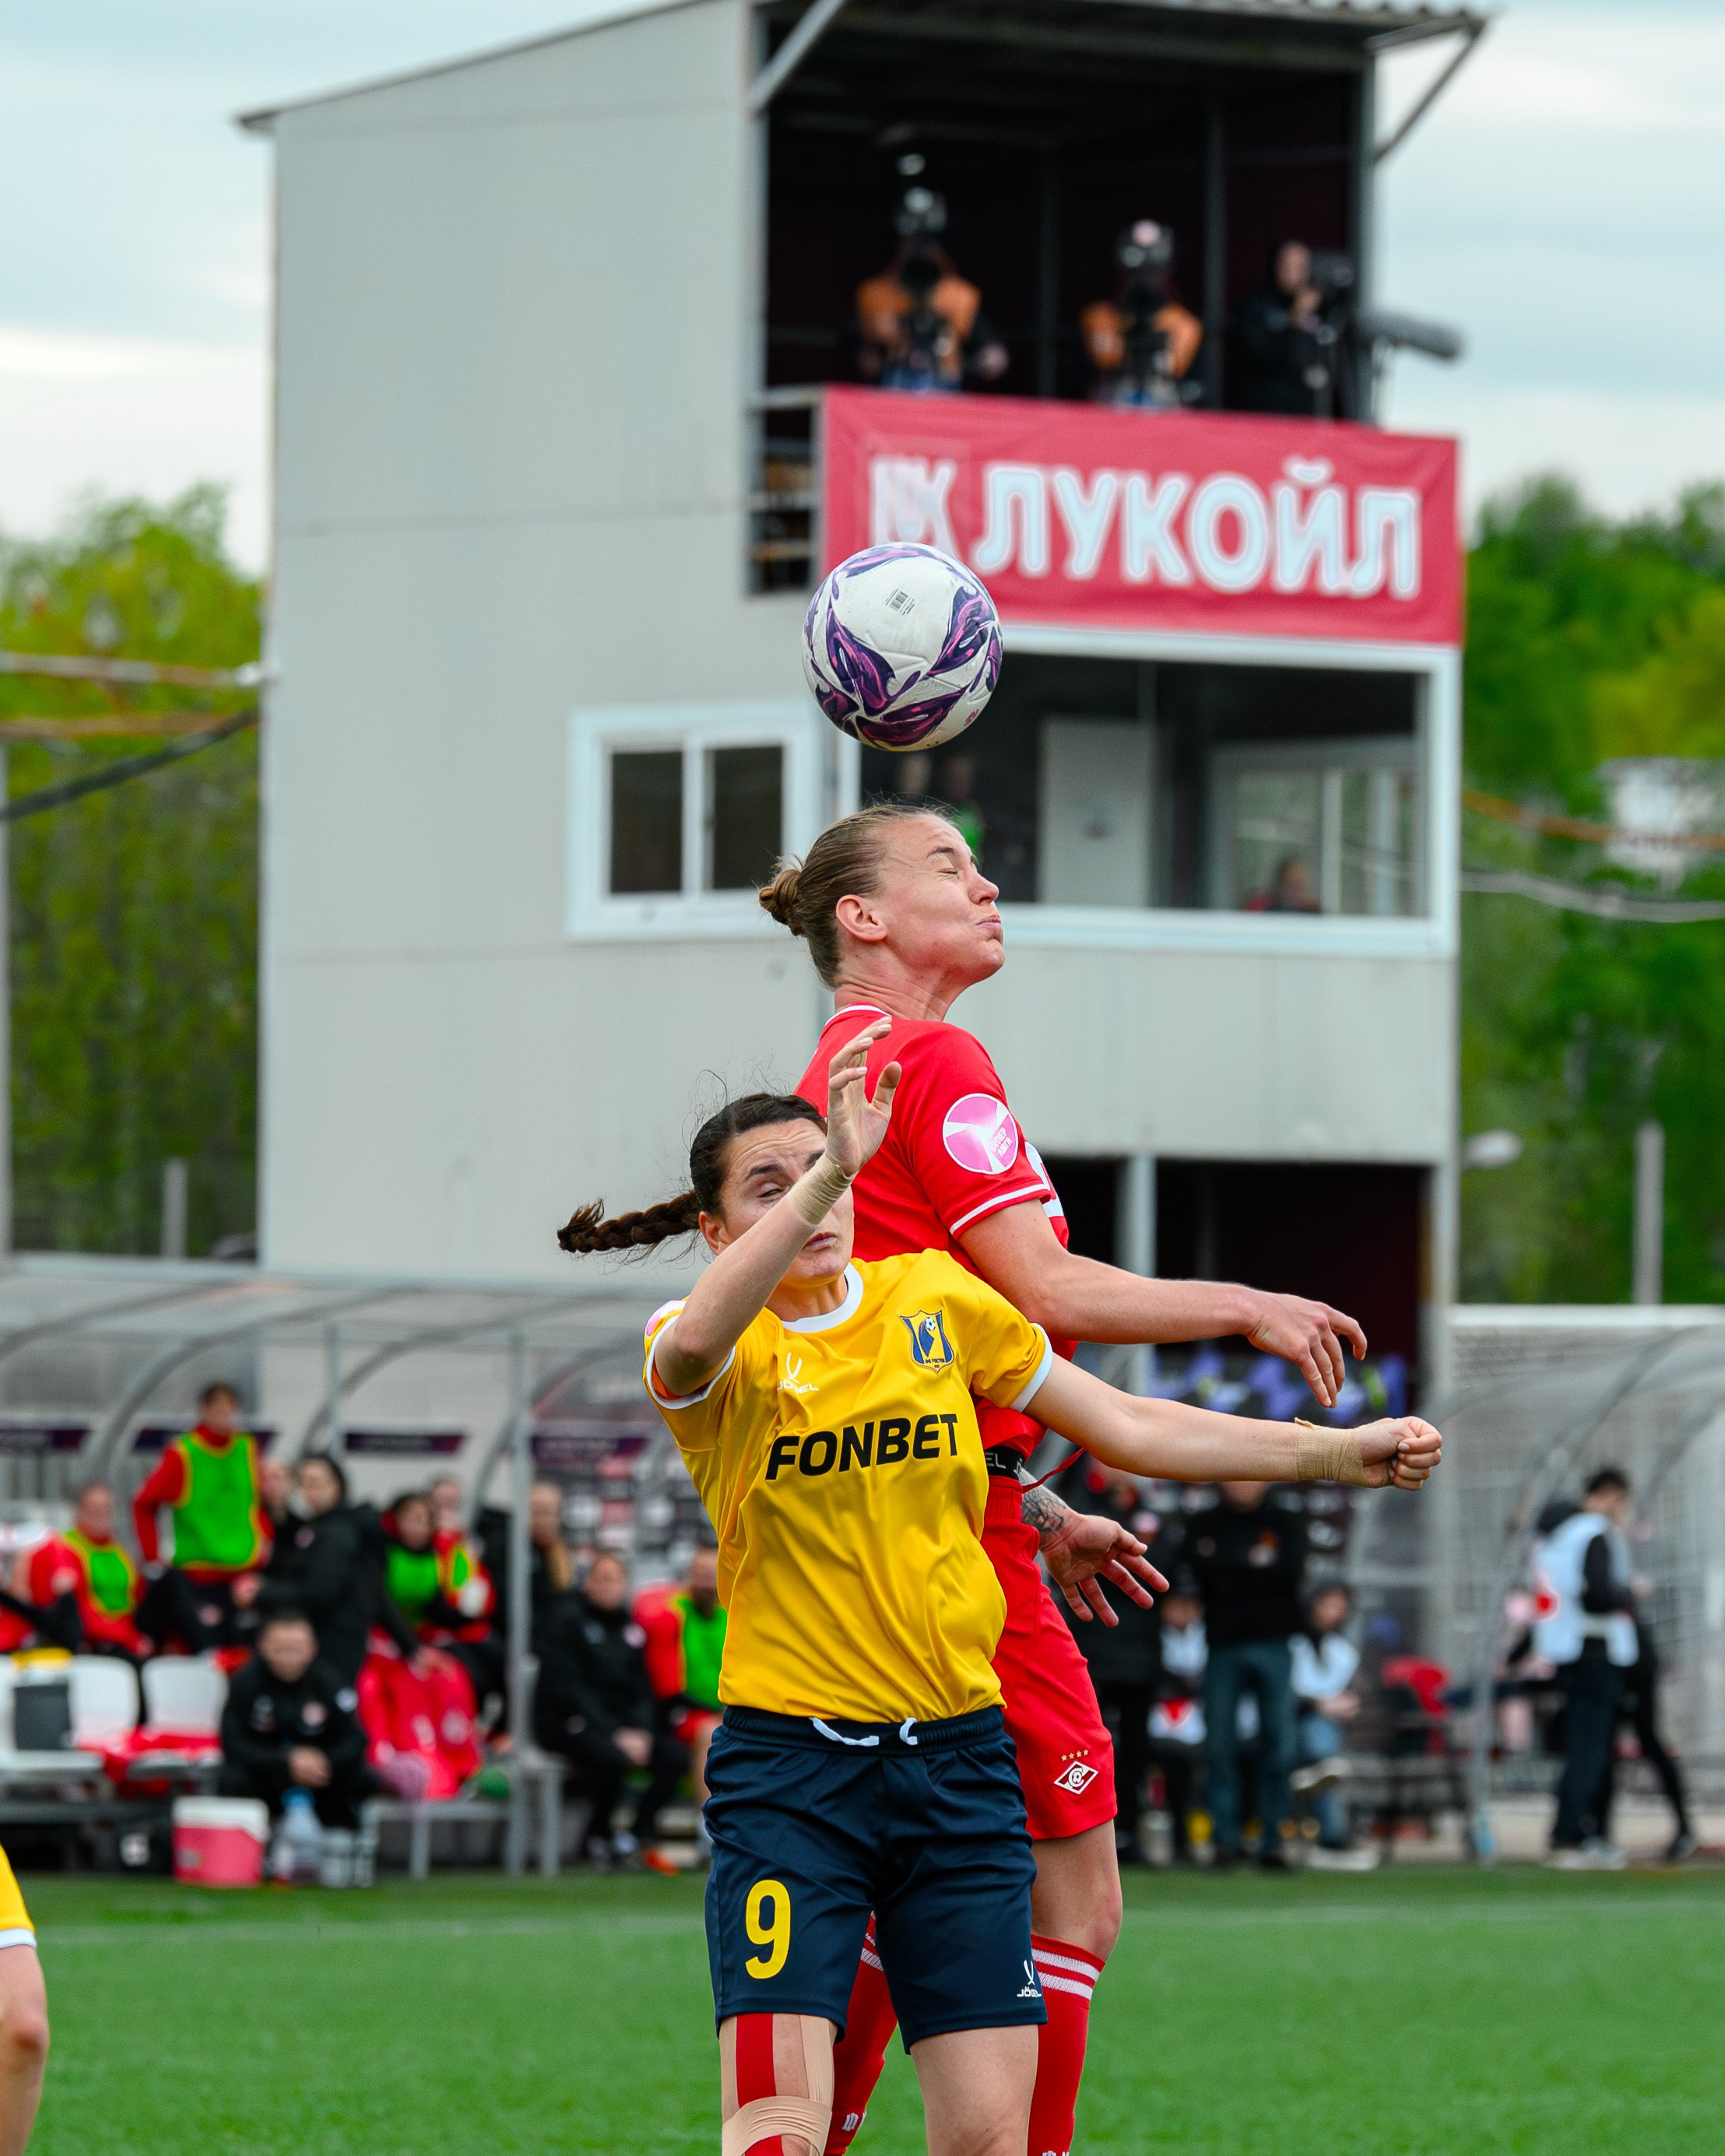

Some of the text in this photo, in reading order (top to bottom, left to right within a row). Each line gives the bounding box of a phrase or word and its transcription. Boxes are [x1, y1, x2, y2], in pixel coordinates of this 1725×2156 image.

[973, 456, 1420, 598] ЛУКОЙЛ
[765, 1413, 958, 1480] FONBET
[745, 1880, 791, 1979] 9
